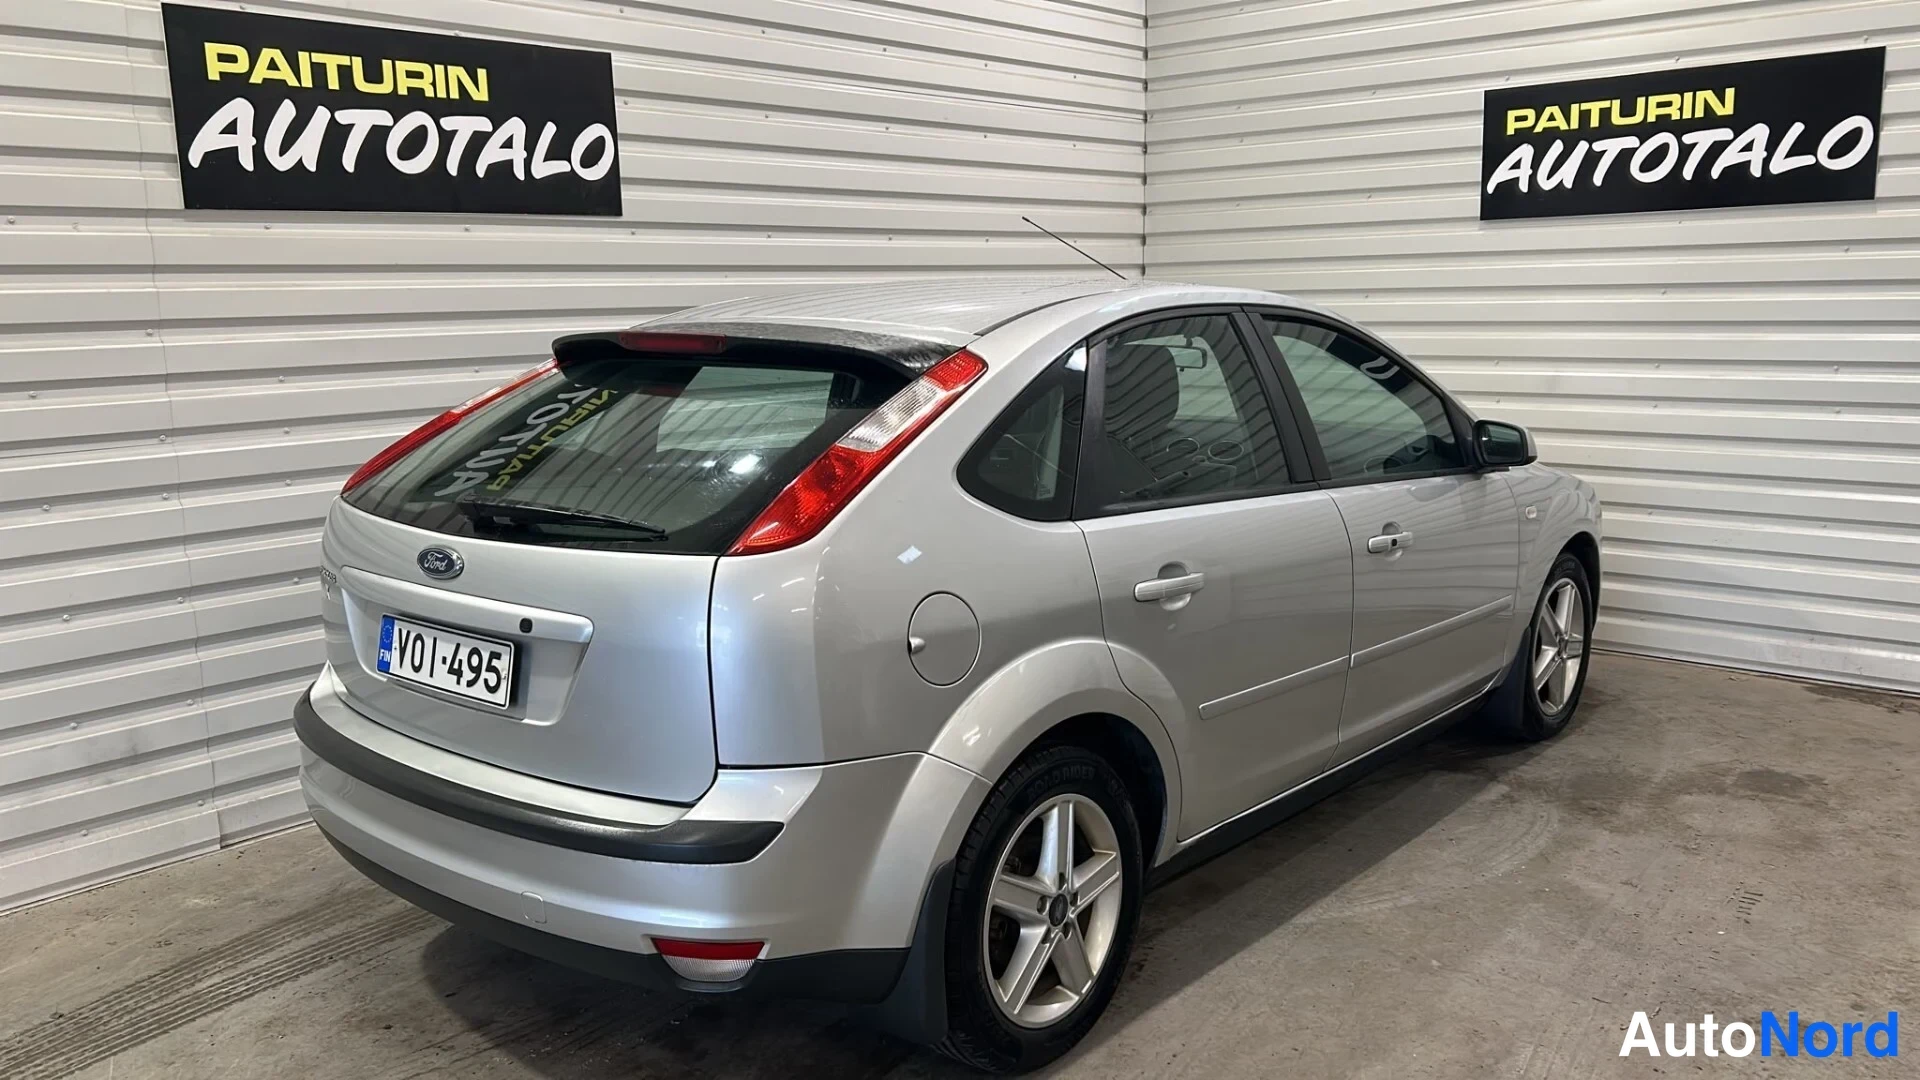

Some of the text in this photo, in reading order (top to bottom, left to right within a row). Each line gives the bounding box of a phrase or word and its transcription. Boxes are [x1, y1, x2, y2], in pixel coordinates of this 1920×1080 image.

[204, 42, 489, 101] PAITURIN
[188, 97, 615, 181] AUTOTALO
[1506, 87, 1736, 135] PAITURIN
[1486, 115, 1874, 194] AUTOTALO
[423, 551, 448, 571] Ford
[378, 649, 391, 663] FIN
[398, 627, 503, 695] VOI-495
